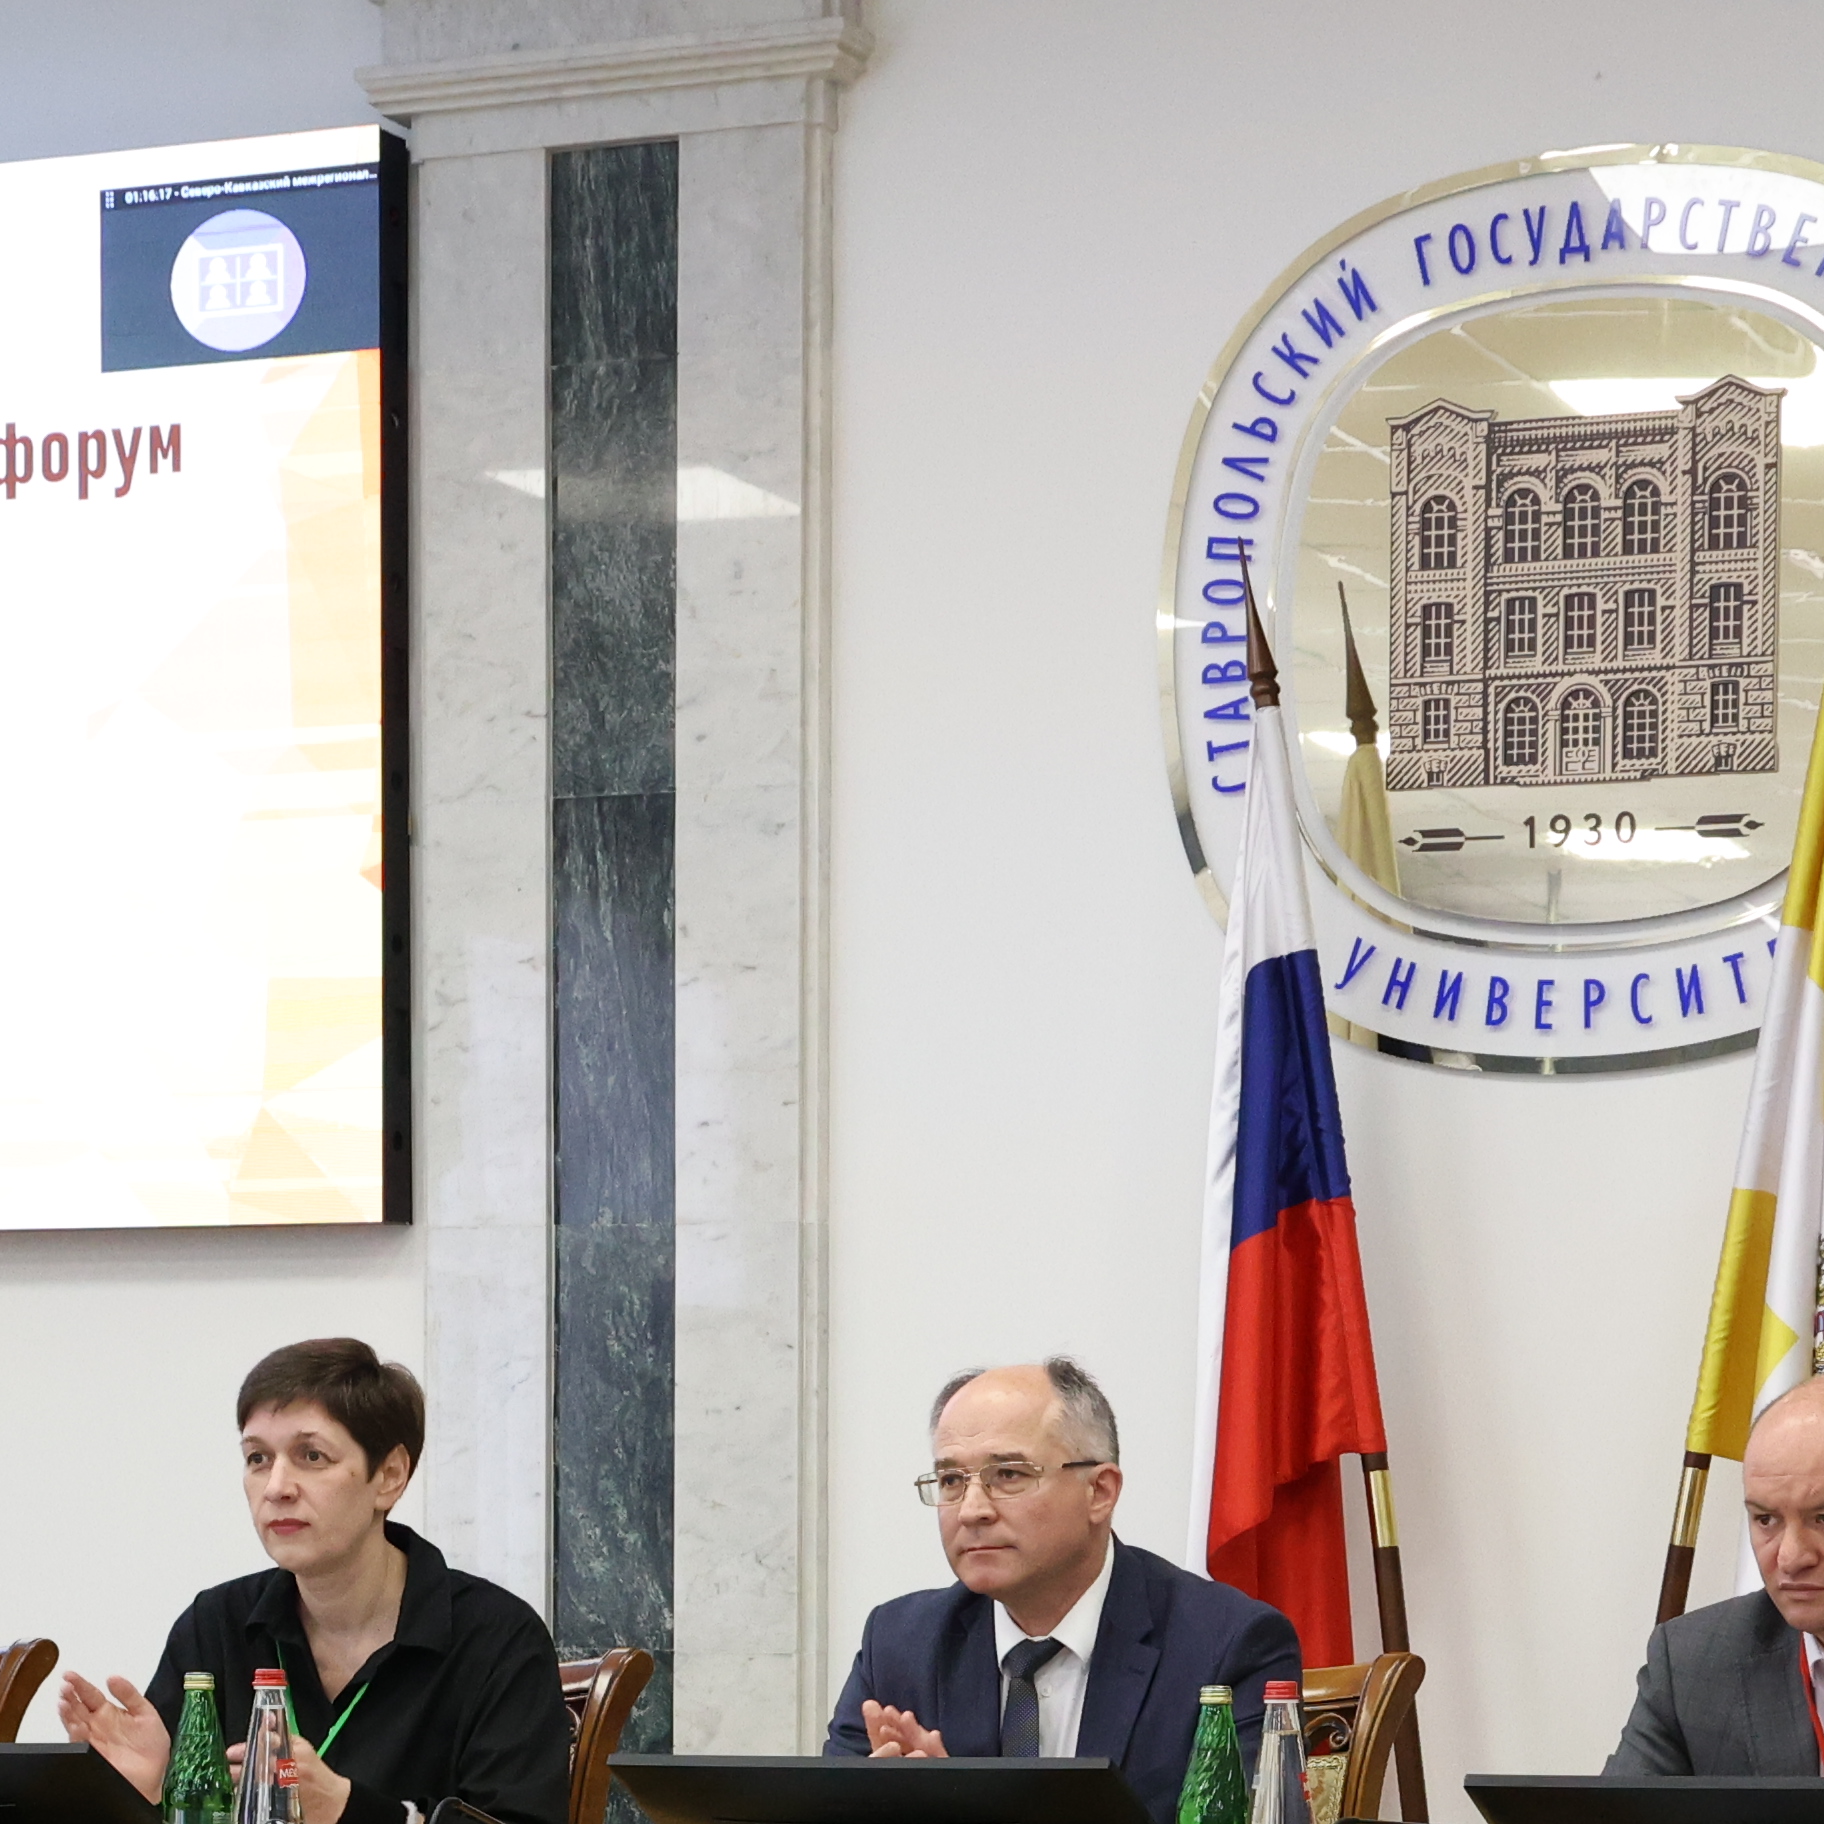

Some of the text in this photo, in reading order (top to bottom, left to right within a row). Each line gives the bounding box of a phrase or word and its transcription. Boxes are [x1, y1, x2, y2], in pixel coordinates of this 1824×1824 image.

[1201, 258, 1378, 795] СТАВРОПОЛЬСКИЙ
[1522, 810, 1639, 850] 1930
[1334, 937, 1778, 1031] УНИВЕРСИТ
